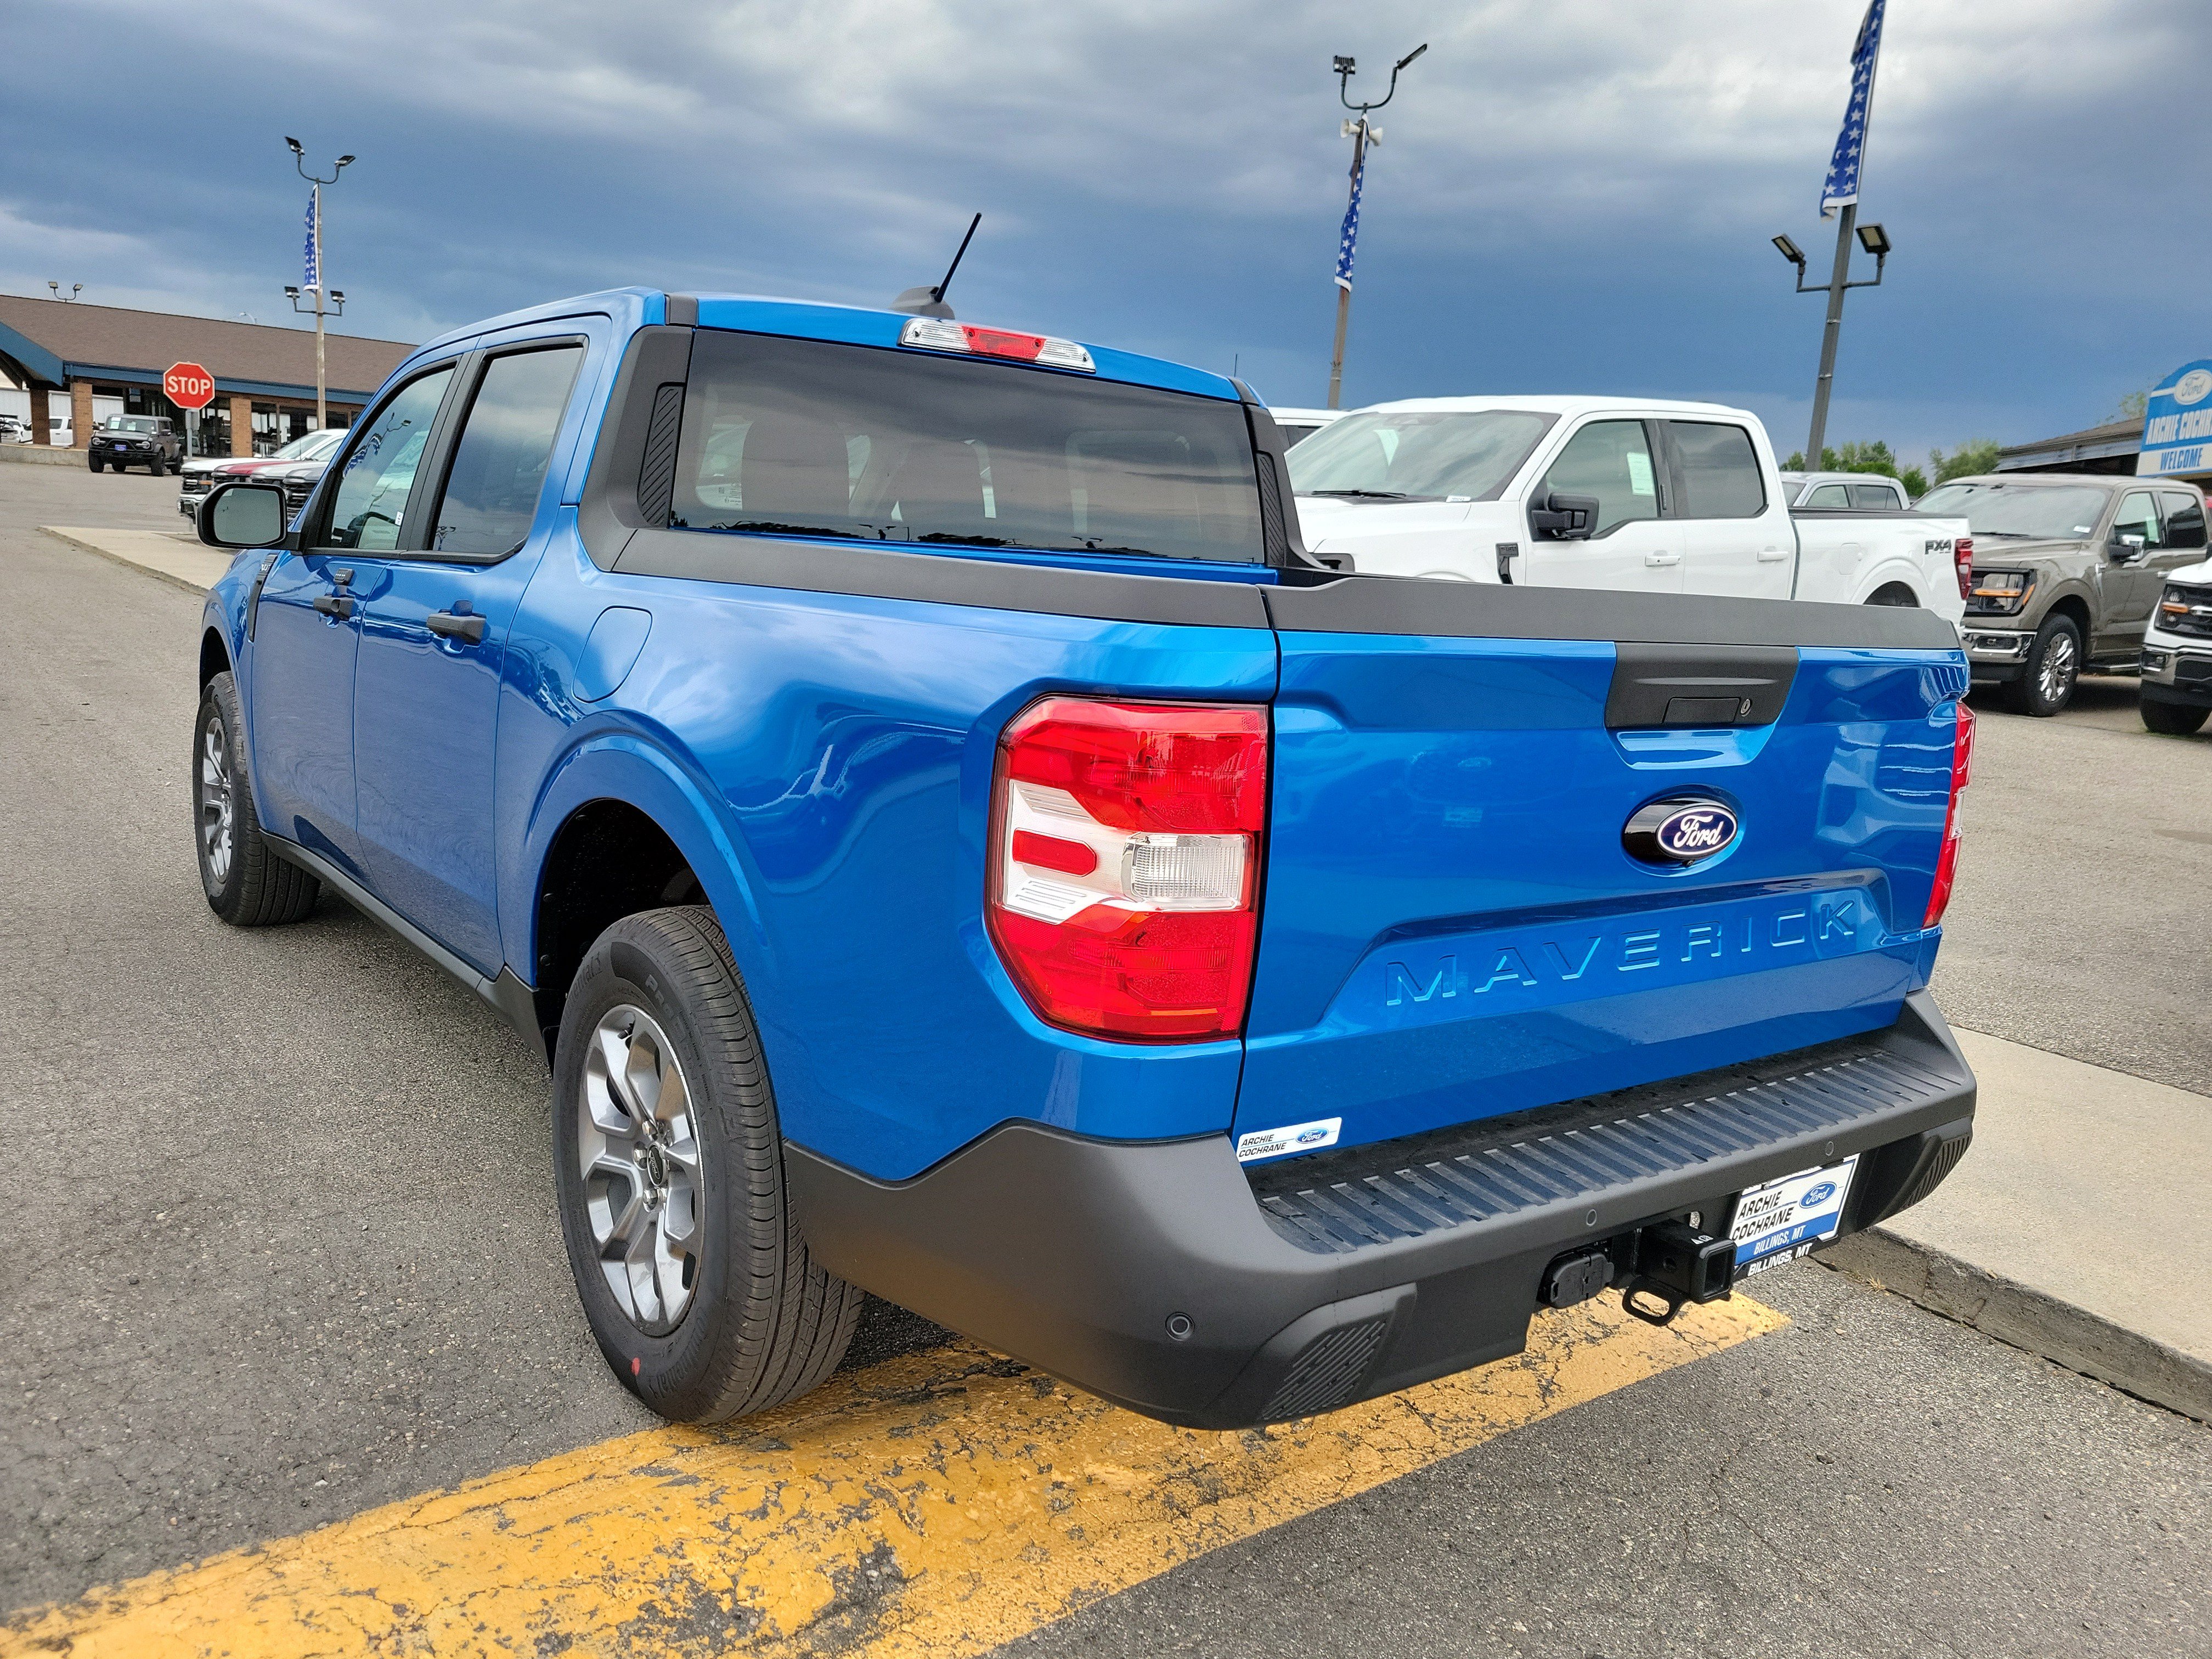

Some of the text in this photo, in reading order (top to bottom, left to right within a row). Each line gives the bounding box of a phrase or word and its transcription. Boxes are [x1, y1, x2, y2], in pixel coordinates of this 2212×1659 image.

[167, 375, 211, 396] STOP
[2181, 376, 2206, 396] Ford
[2145, 414, 2180, 445] ARCHIE
[2160, 448, 2203, 470] WELCOME
[1925, 539, 1951, 555] FX4
[1673, 815, 1724, 848] Ford
[1385, 900, 1855, 1006] MAVERICK
[1241, 1134, 1274, 1147] ARCHIE
[1301, 1130, 1323, 1142] Ford
[1238, 1142, 1287, 1158] COCHRANE
[1737, 1190, 1783, 1220] ARCHIE
[1805, 1186, 1830, 1205] Ford
[1731, 1206, 1795, 1242] COCHRANE
[1753, 1225, 1807, 1255] BILLINGS, MT
[1747, 1243, 1813, 1277] BILLINGS, MT
